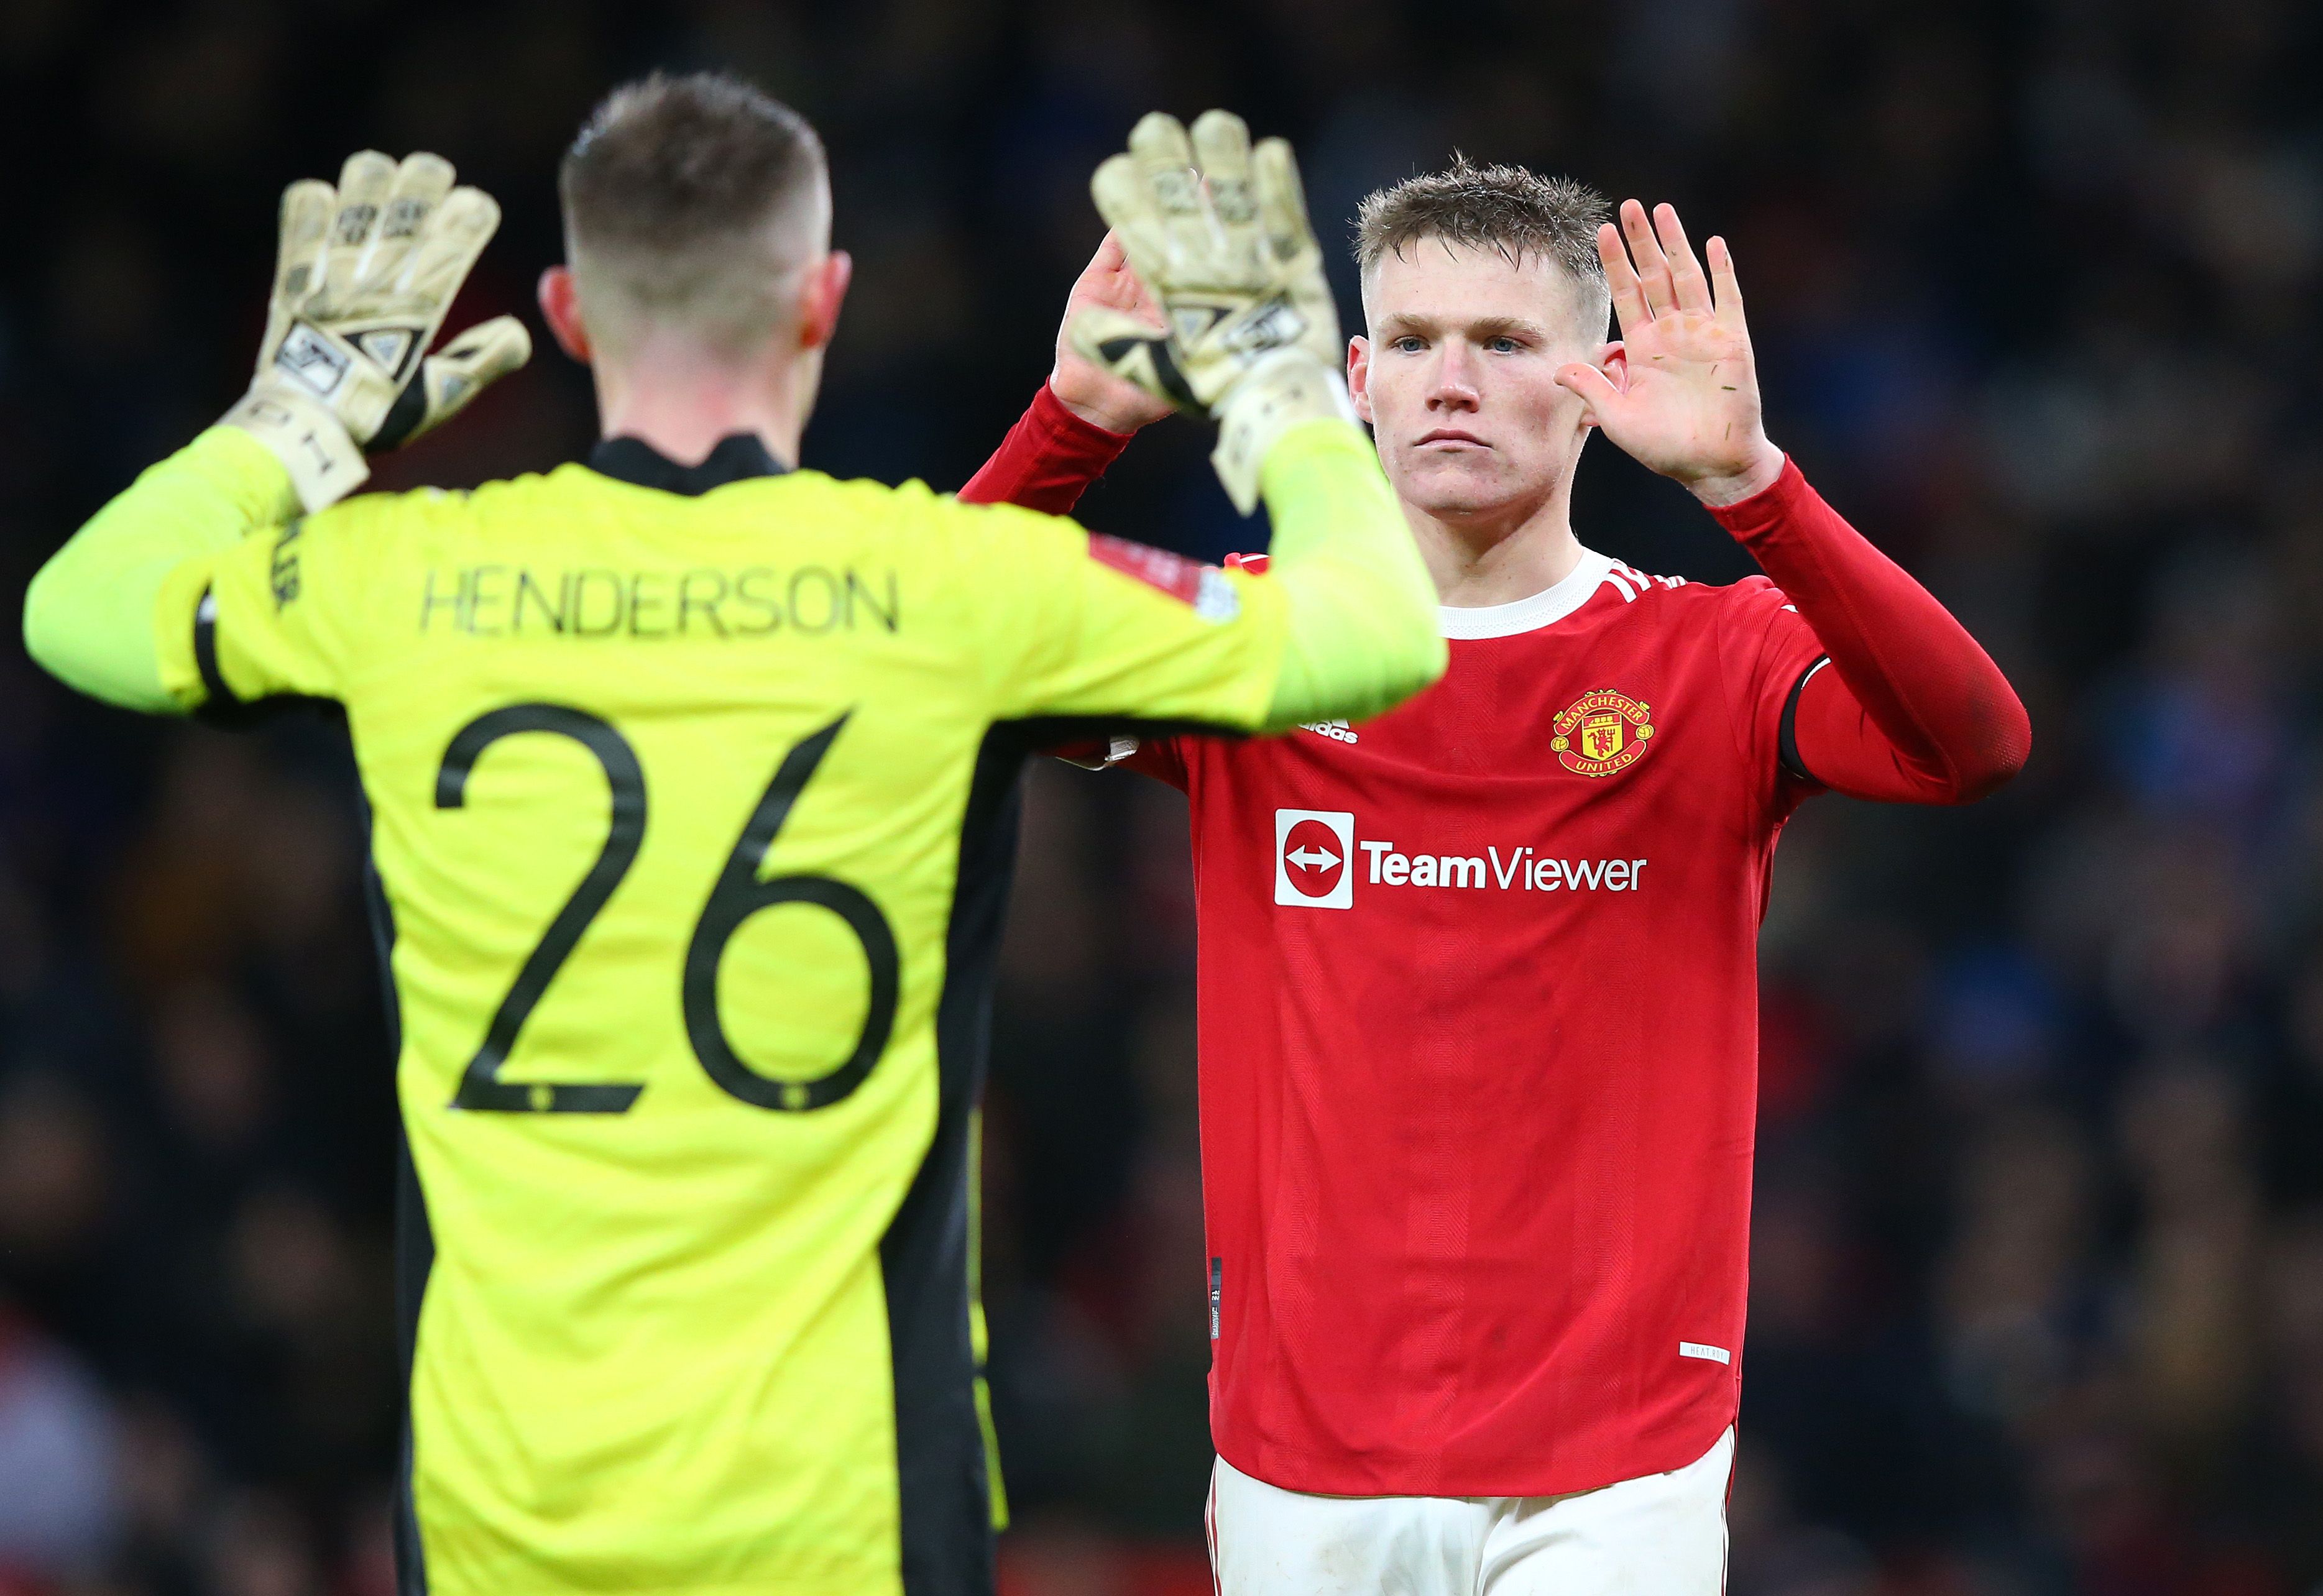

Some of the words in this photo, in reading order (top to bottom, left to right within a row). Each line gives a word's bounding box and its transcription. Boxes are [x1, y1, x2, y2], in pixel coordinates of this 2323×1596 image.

[418, 564, 899, 640] HENDERSON
[1297, 720, 1358, 744] das
[1560, 697, 1644, 730] MANCHESTER
[1576, 753, 1632, 771] UNITED
[1360, 840, 1647, 891] TeamViewer
[435, 702, 901, 1112] 26
